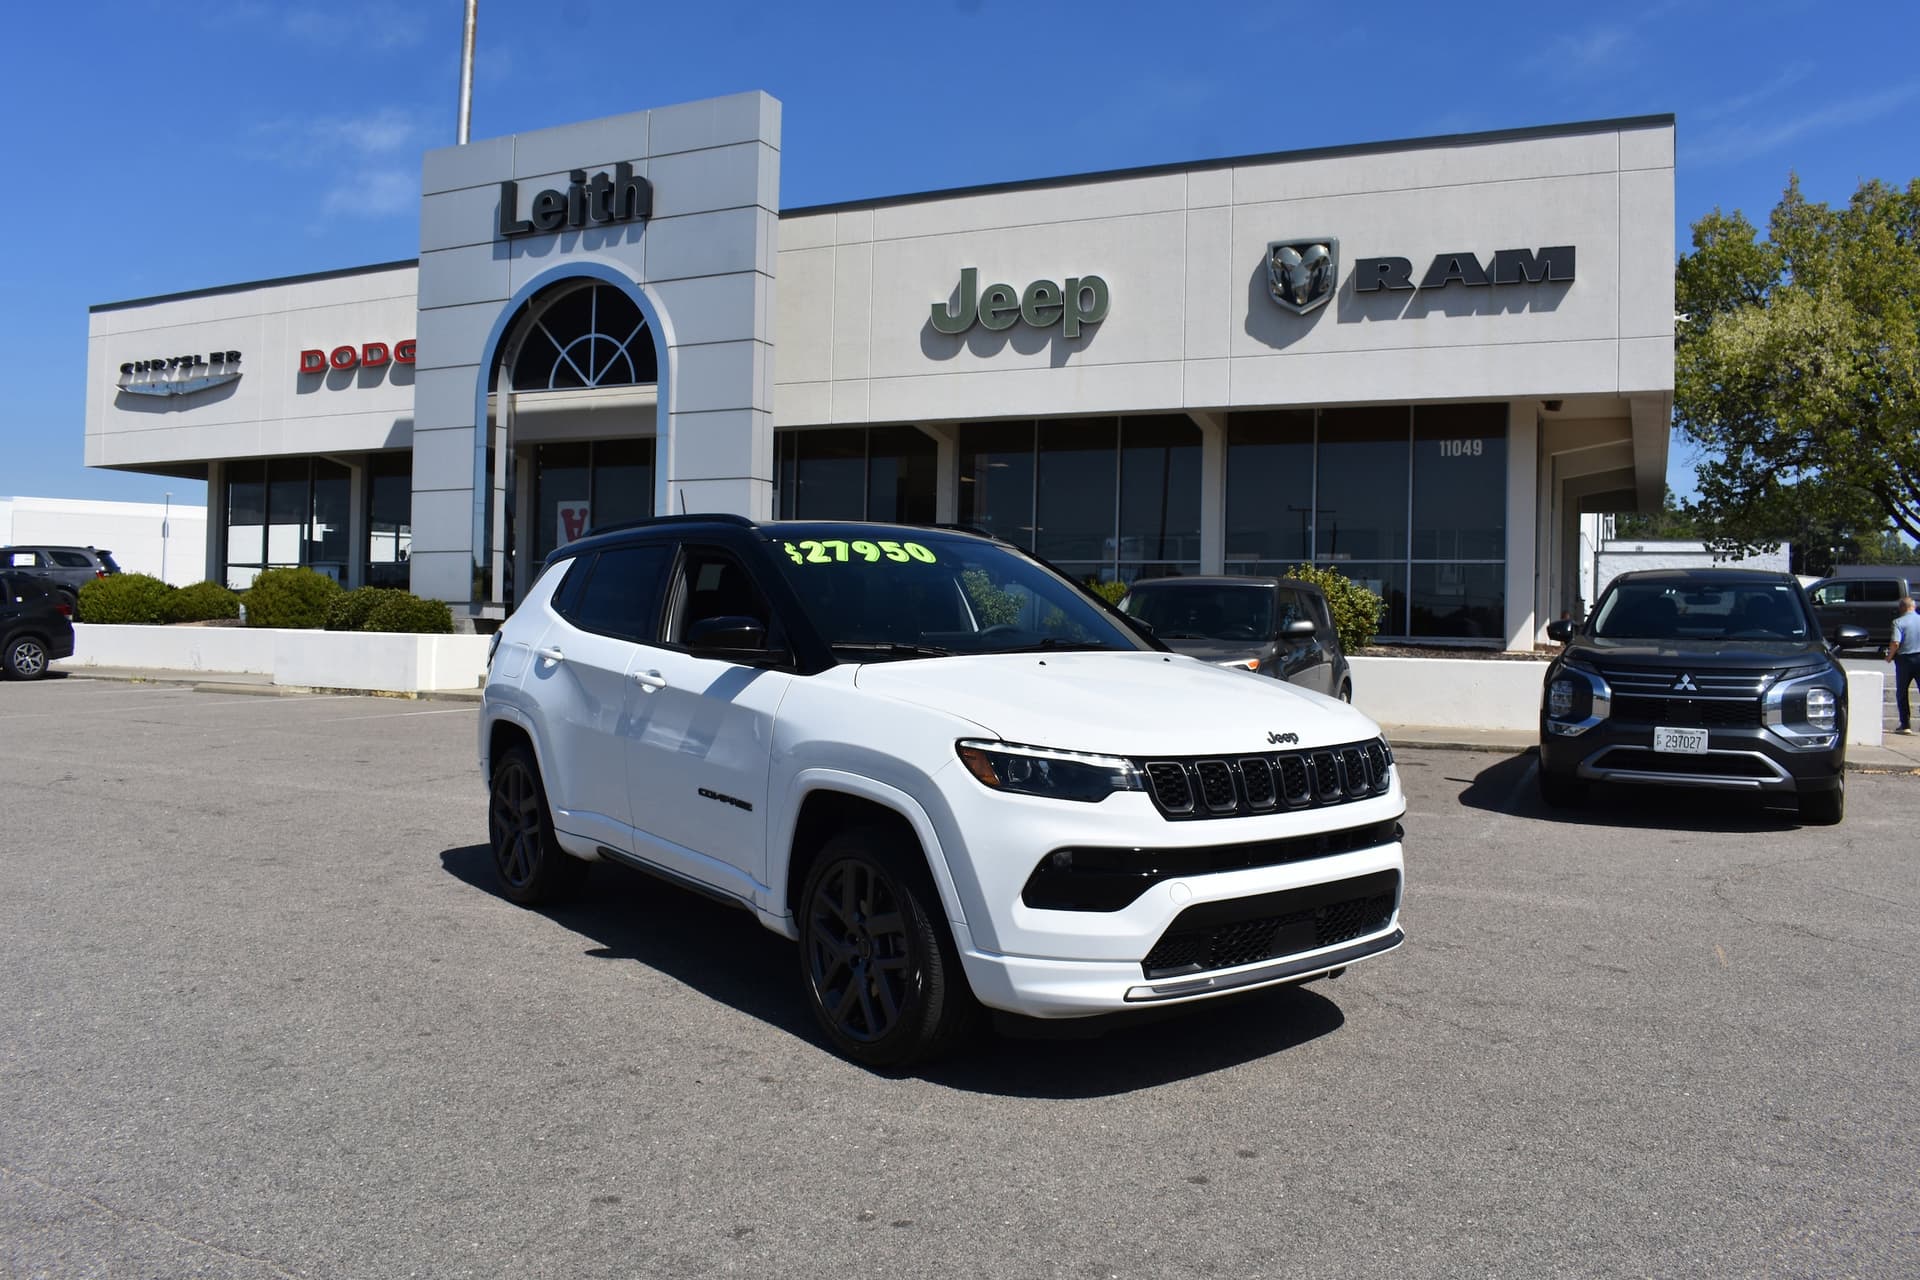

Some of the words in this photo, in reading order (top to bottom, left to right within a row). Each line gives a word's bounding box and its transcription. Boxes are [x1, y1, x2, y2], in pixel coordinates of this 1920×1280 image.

[500, 161, 653, 236] Leith
[1355, 246, 1576, 292] RAM
[931, 267, 1110, 338] Jeep
[120, 350, 242, 375] CHRYSLER
[300, 339, 416, 373] DODG
[1440, 439, 1483, 457] 11049
[784, 540, 937, 565] $27950
[1267, 731, 1299, 745] Jeep
[1665, 734, 1702, 749] 297027
